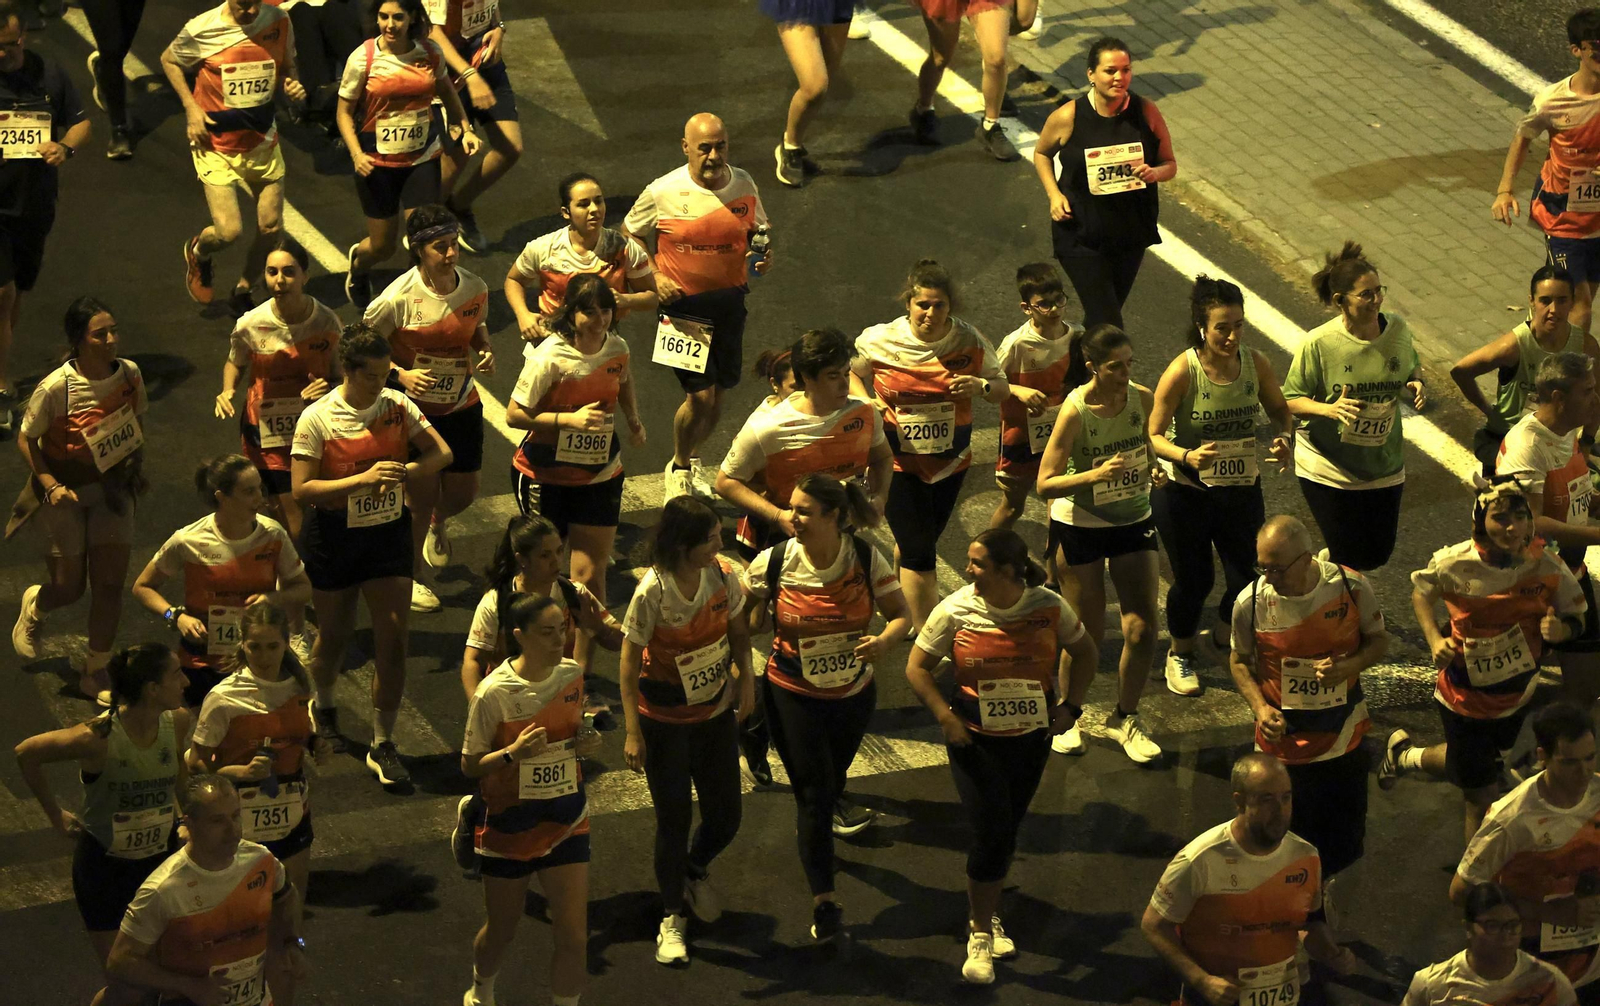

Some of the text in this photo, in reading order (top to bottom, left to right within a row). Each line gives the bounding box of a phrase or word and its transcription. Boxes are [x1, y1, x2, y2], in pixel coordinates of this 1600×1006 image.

[228, 79, 270, 96] 21752
[1, 129, 42, 145] 23451
[382, 126, 424, 142] 21748
[1098, 163, 1133, 182] 3743
[660, 335, 702, 358] 16612
[1332, 382, 1403, 395] CD.RUNNING
[1190, 403, 1260, 421] C.D.RUNNING
[267, 415, 303, 435] 153
[903, 422, 949, 441] 22006
[1035, 423, 1055, 440] 23
[1202, 418, 1253, 434] sano
[97, 425, 135, 458] 21040
[565, 433, 607, 451] 13966
[1212, 459, 1246, 476] 1800
[783, 611, 800, 624] 37
[216, 625, 241, 642] 14
[809, 652, 857, 676] 23392
[964, 656, 984, 668] 37
[1474, 645, 1522, 673] 17315
[688, 660, 730, 691] 2338
[986, 700, 1039, 718] 23368
[532, 763, 566, 784] 5861
[118, 790, 167, 808] sano
[251, 808, 290, 828] 7351
[125, 828, 161, 850] 1818
[1248, 983, 1295, 1006] 10749
